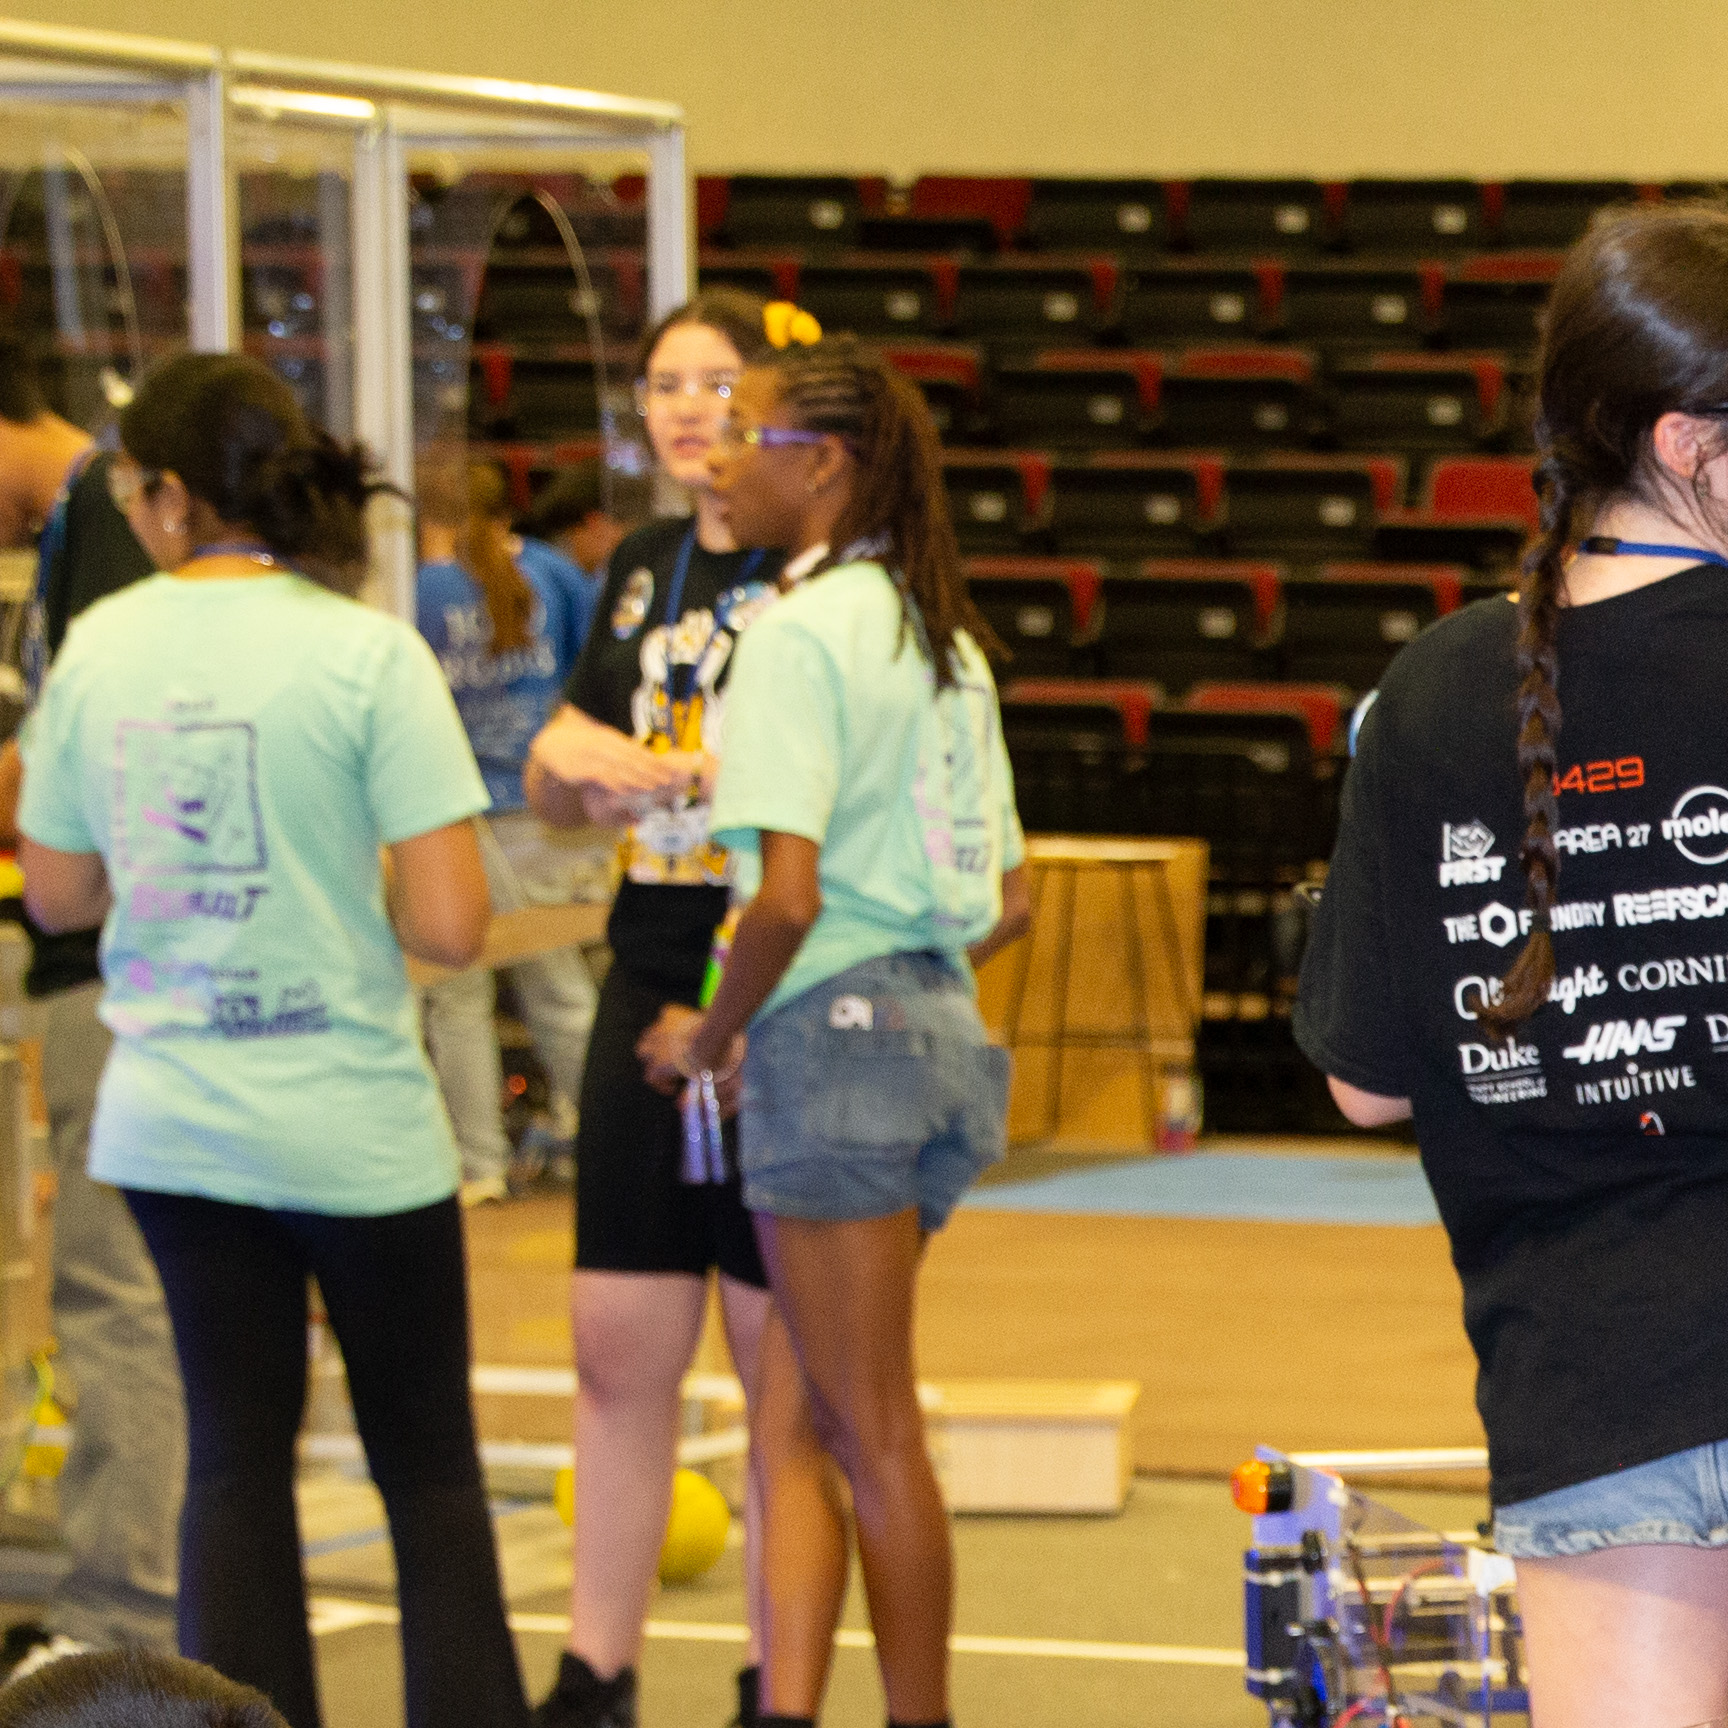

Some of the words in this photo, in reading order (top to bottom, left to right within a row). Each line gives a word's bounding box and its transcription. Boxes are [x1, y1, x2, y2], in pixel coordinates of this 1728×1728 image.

[1626, 824, 1652, 848] 27
[1440, 856, 1508, 889] FIRST
[1443, 913, 1481, 944] THE
[1458, 1035, 1541, 1075] Duke
[1562, 1014, 1688, 1066] HAAS
[1575, 1062, 1697, 1106] INTUITIVE
